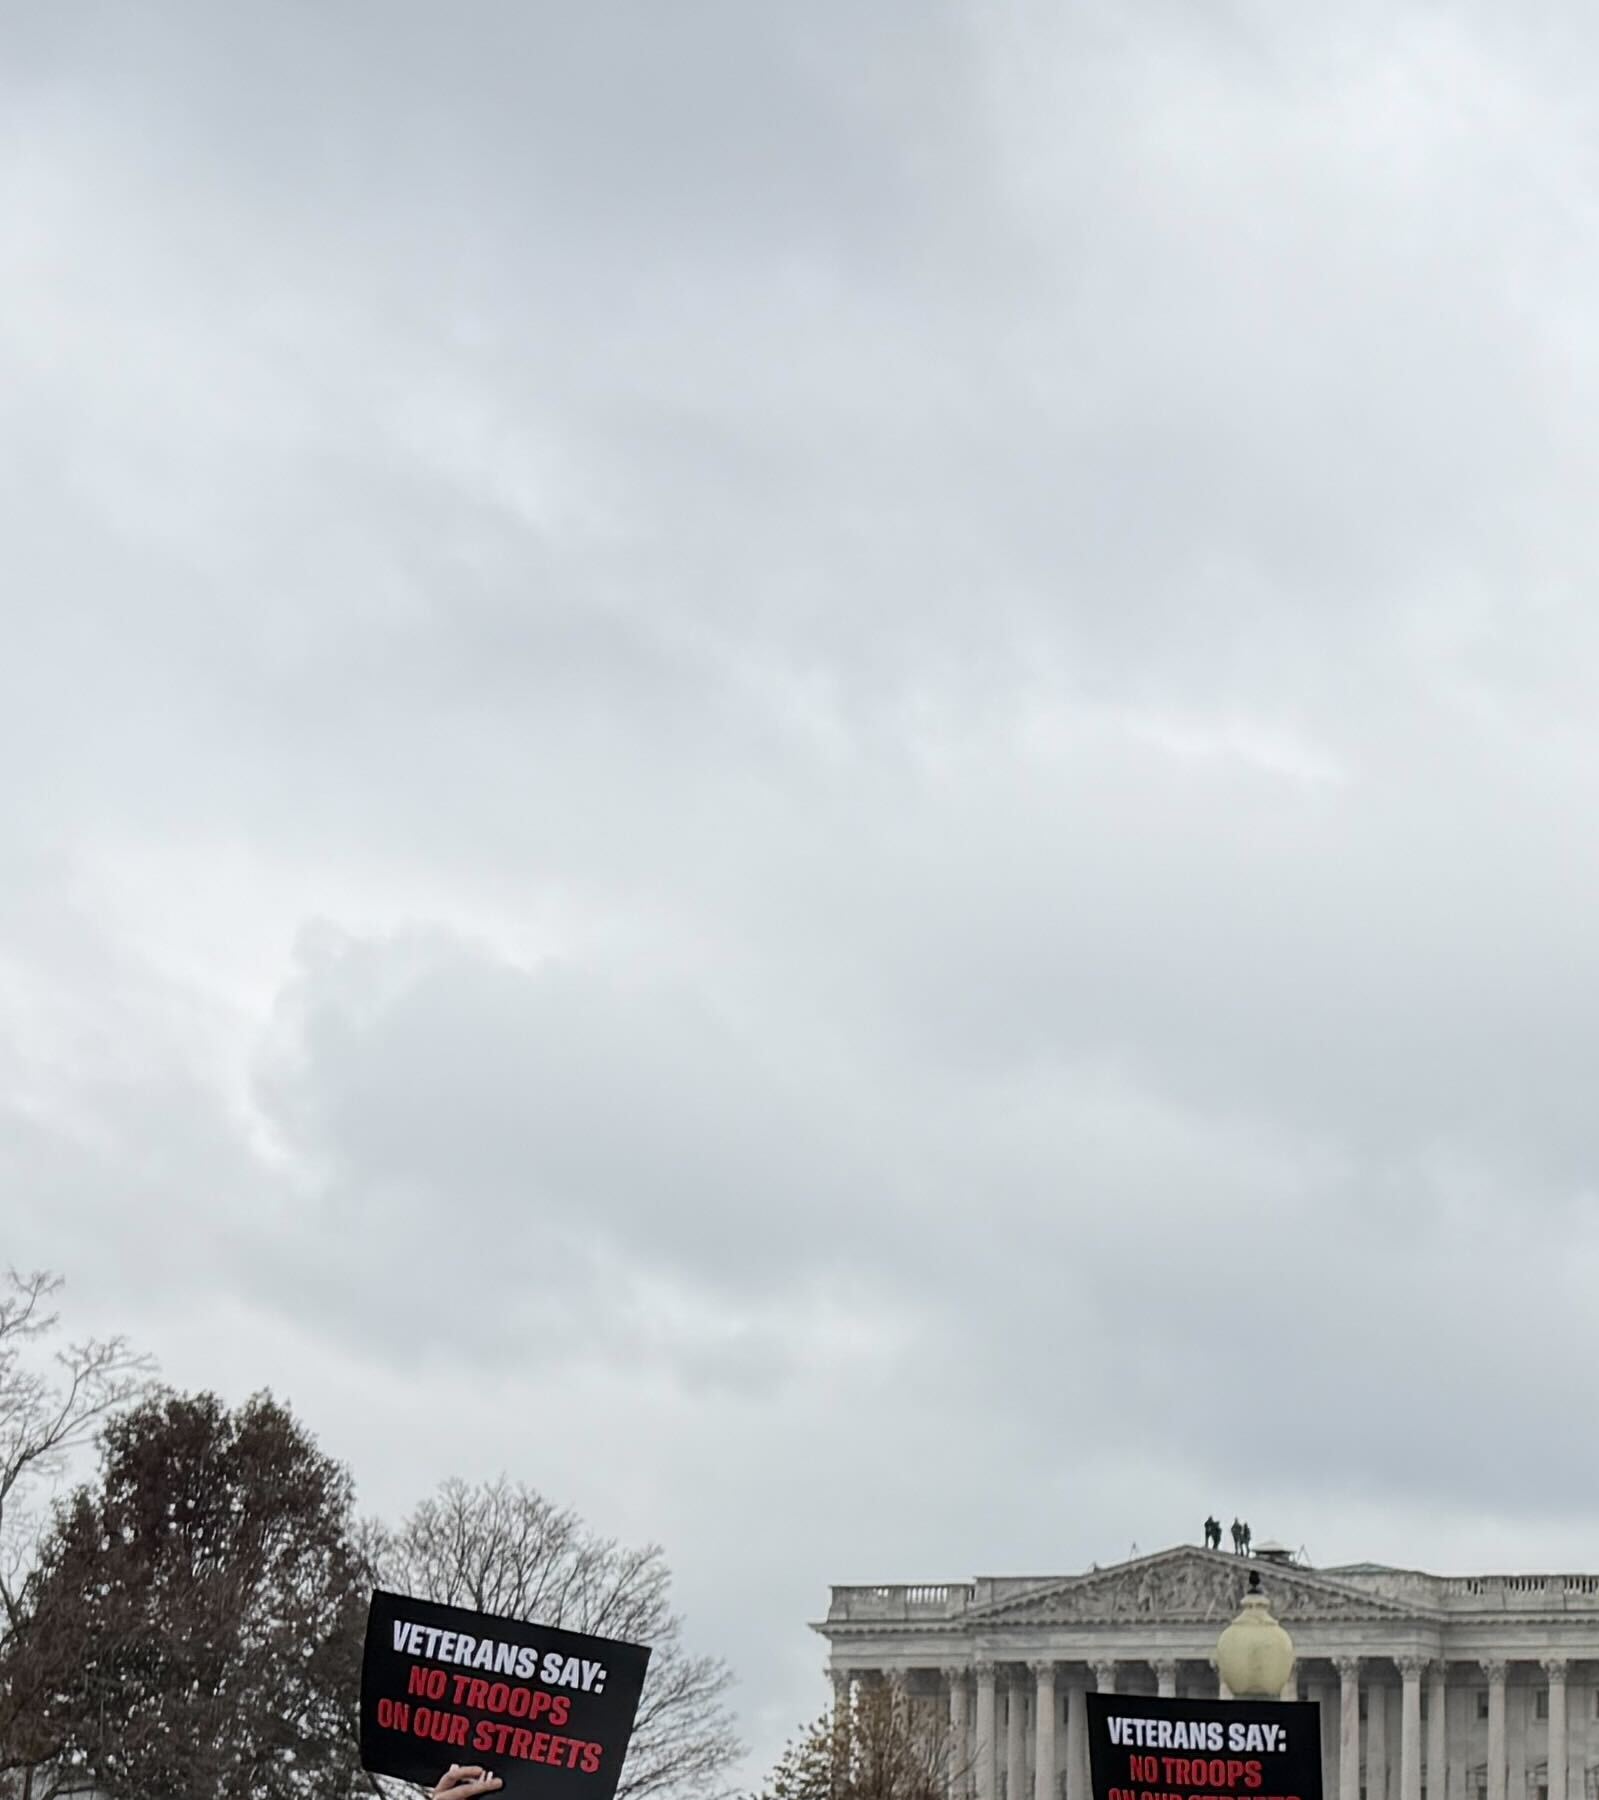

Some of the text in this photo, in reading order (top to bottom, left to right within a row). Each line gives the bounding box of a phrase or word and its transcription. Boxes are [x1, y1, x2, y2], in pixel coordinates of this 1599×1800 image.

[393, 1620, 608, 1693] VETERANS SAY:
[408, 1666, 570, 1726] NO TROOPS
[377, 1699, 603, 1773] ON OUR STREETS
[1107, 1716, 1286, 1752] VETERANS SAY:
[1130, 1755, 1262, 1788] NO TROOPS
